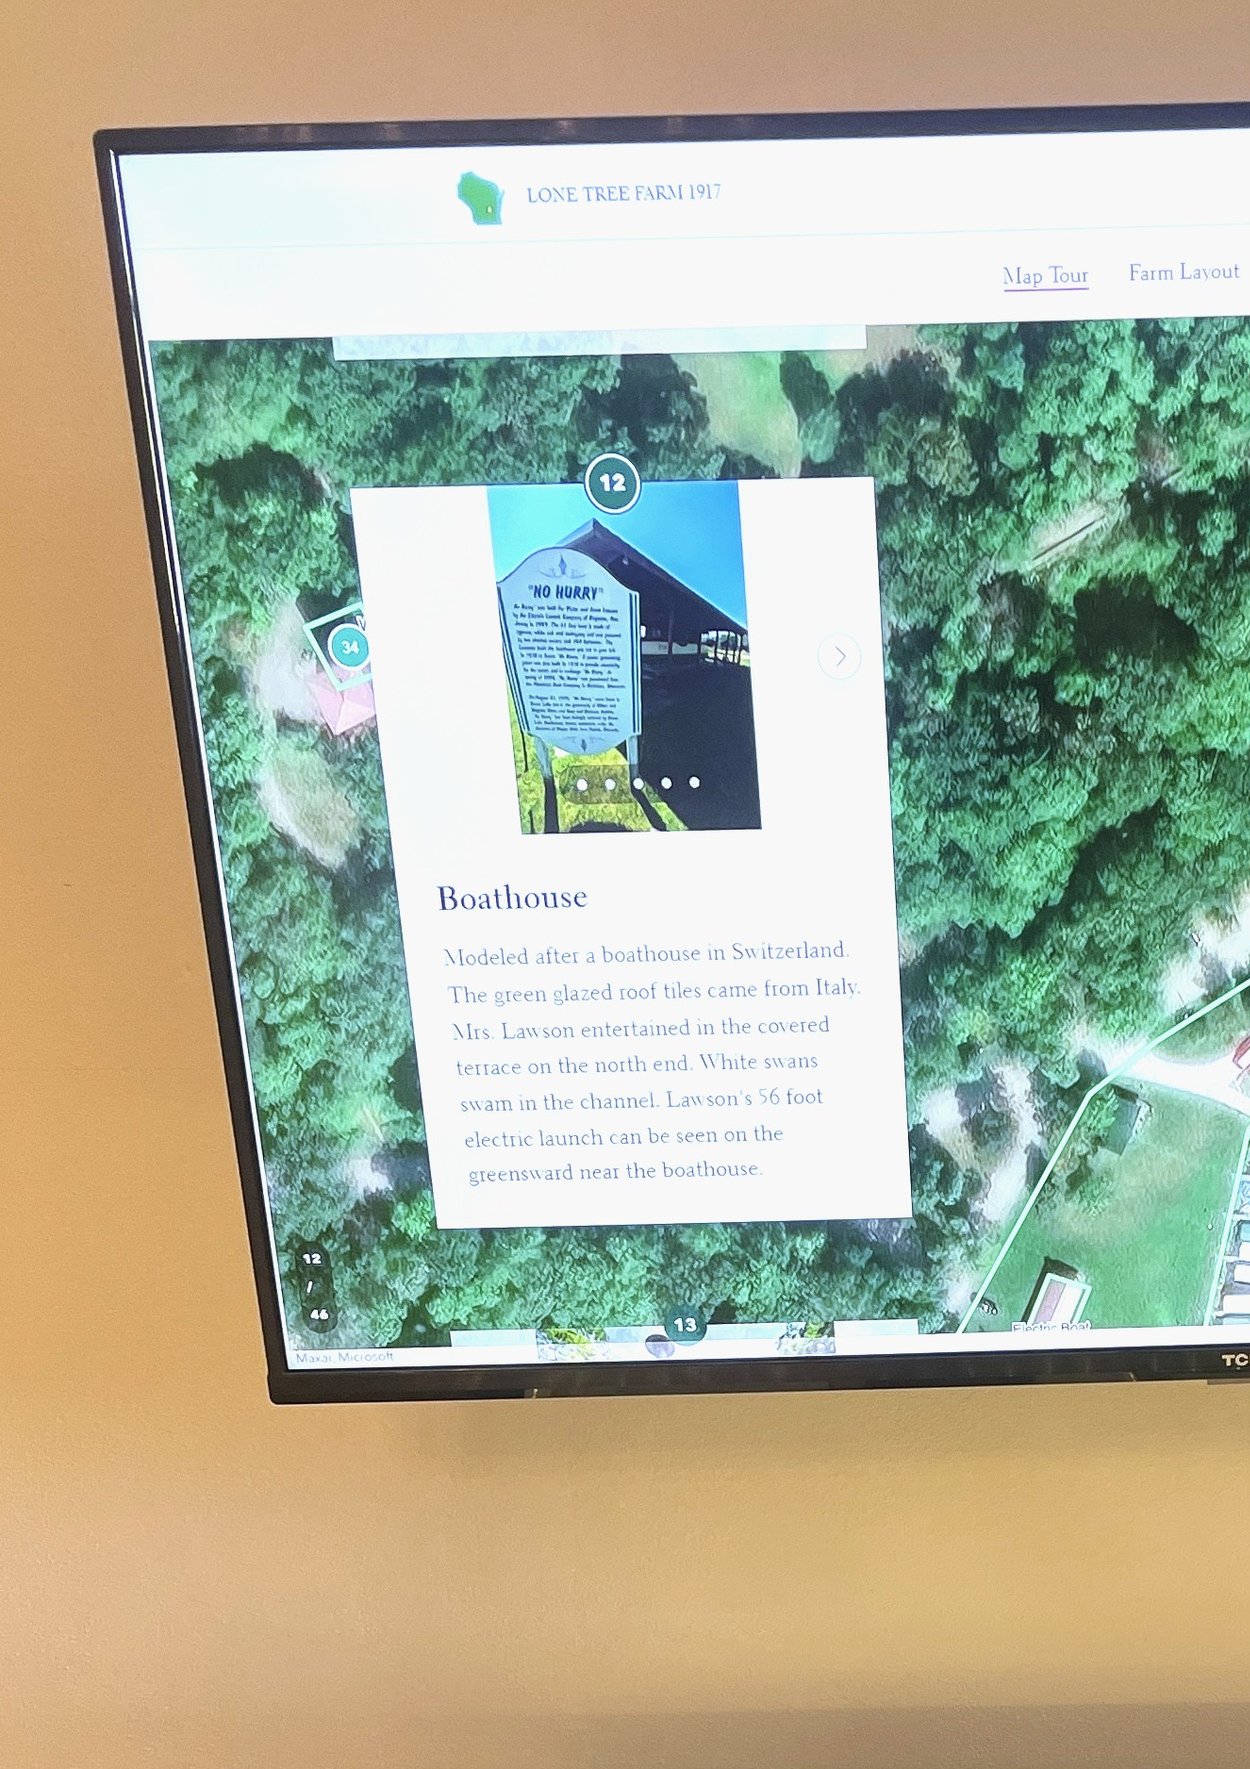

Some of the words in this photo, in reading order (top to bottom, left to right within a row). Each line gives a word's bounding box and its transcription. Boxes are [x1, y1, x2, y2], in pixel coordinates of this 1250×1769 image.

[527, 187, 578, 203] LONE
[583, 186, 629, 202] TREE
[635, 185, 682, 200] FARM
[689, 184, 720, 200] 1917
[1003, 266, 1042, 286] Map
[1048, 265, 1089, 284] Tour
[1130, 264, 1173, 281] Farm
[1180, 262, 1239, 280] Layout
[600, 473, 626, 493] 12
[342, 640, 360, 655] 34
[438, 884, 588, 912] Boathouse
[444, 946, 528, 968] Modeled
[536, 945, 579, 966] after
[586, 949, 596, 964] a
[601, 944, 700, 964] boathouse
[708, 944, 725, 961] in
[732, 940, 850, 961] Switzerland.
[448, 984, 488, 1005] The
[494, 986, 547, 1008] green
[554, 981, 612, 1006] glazed
[619, 980, 658, 1001] roof
[662, 979, 701, 1000] tiles
[708, 981, 758, 999] came
[764, 978, 809, 998] from
[816, 977, 861, 999] Italy.
[452, 1021, 495, 1041] Mrs.
[502, 1020, 575, 1040] Lawson
[581, 1019, 691, 1039] entertained
[697, 1018, 714, 1036] in
[721, 1016, 751, 1035] the
[758, 1014, 829, 1035] covered
[457, 1058, 521, 1076] terrace
[528, 1060, 552, 1075] on
[558, 1055, 588, 1075] the
[594, 1054, 647, 1074] north
[653, 1053, 694, 1072] end.
[699, 1051, 758, 1071] White
[764, 1053, 818, 1071] swans
[461, 1095, 513, 1112] swam
[519, 1092, 538, 1111] in
[544, 1092, 573, 1111] the
[579, 1090, 659, 1110] channel.
[666, 1088, 752, 1109] Lawson's
[758, 1087, 780, 1106] 56
[786, 1086, 823, 1106] foot
[465, 1128, 532, 1149] electric
[539, 1127, 603, 1147] launch
[609, 1130, 642, 1146] can
[648, 1126, 670, 1145] be
[676, 1128, 717, 1144] seen
[724, 1126, 748, 1142] on
[754, 1124, 783, 1142] the
[469, 1163, 573, 1186] greensward
[579, 1166, 619, 1181] near
[626, 1161, 657, 1180] the
[662, 1159, 762, 1179] boathouse.
[303, 1253, 321, 1264] 12
[674, 1317, 697, 1332] 13
